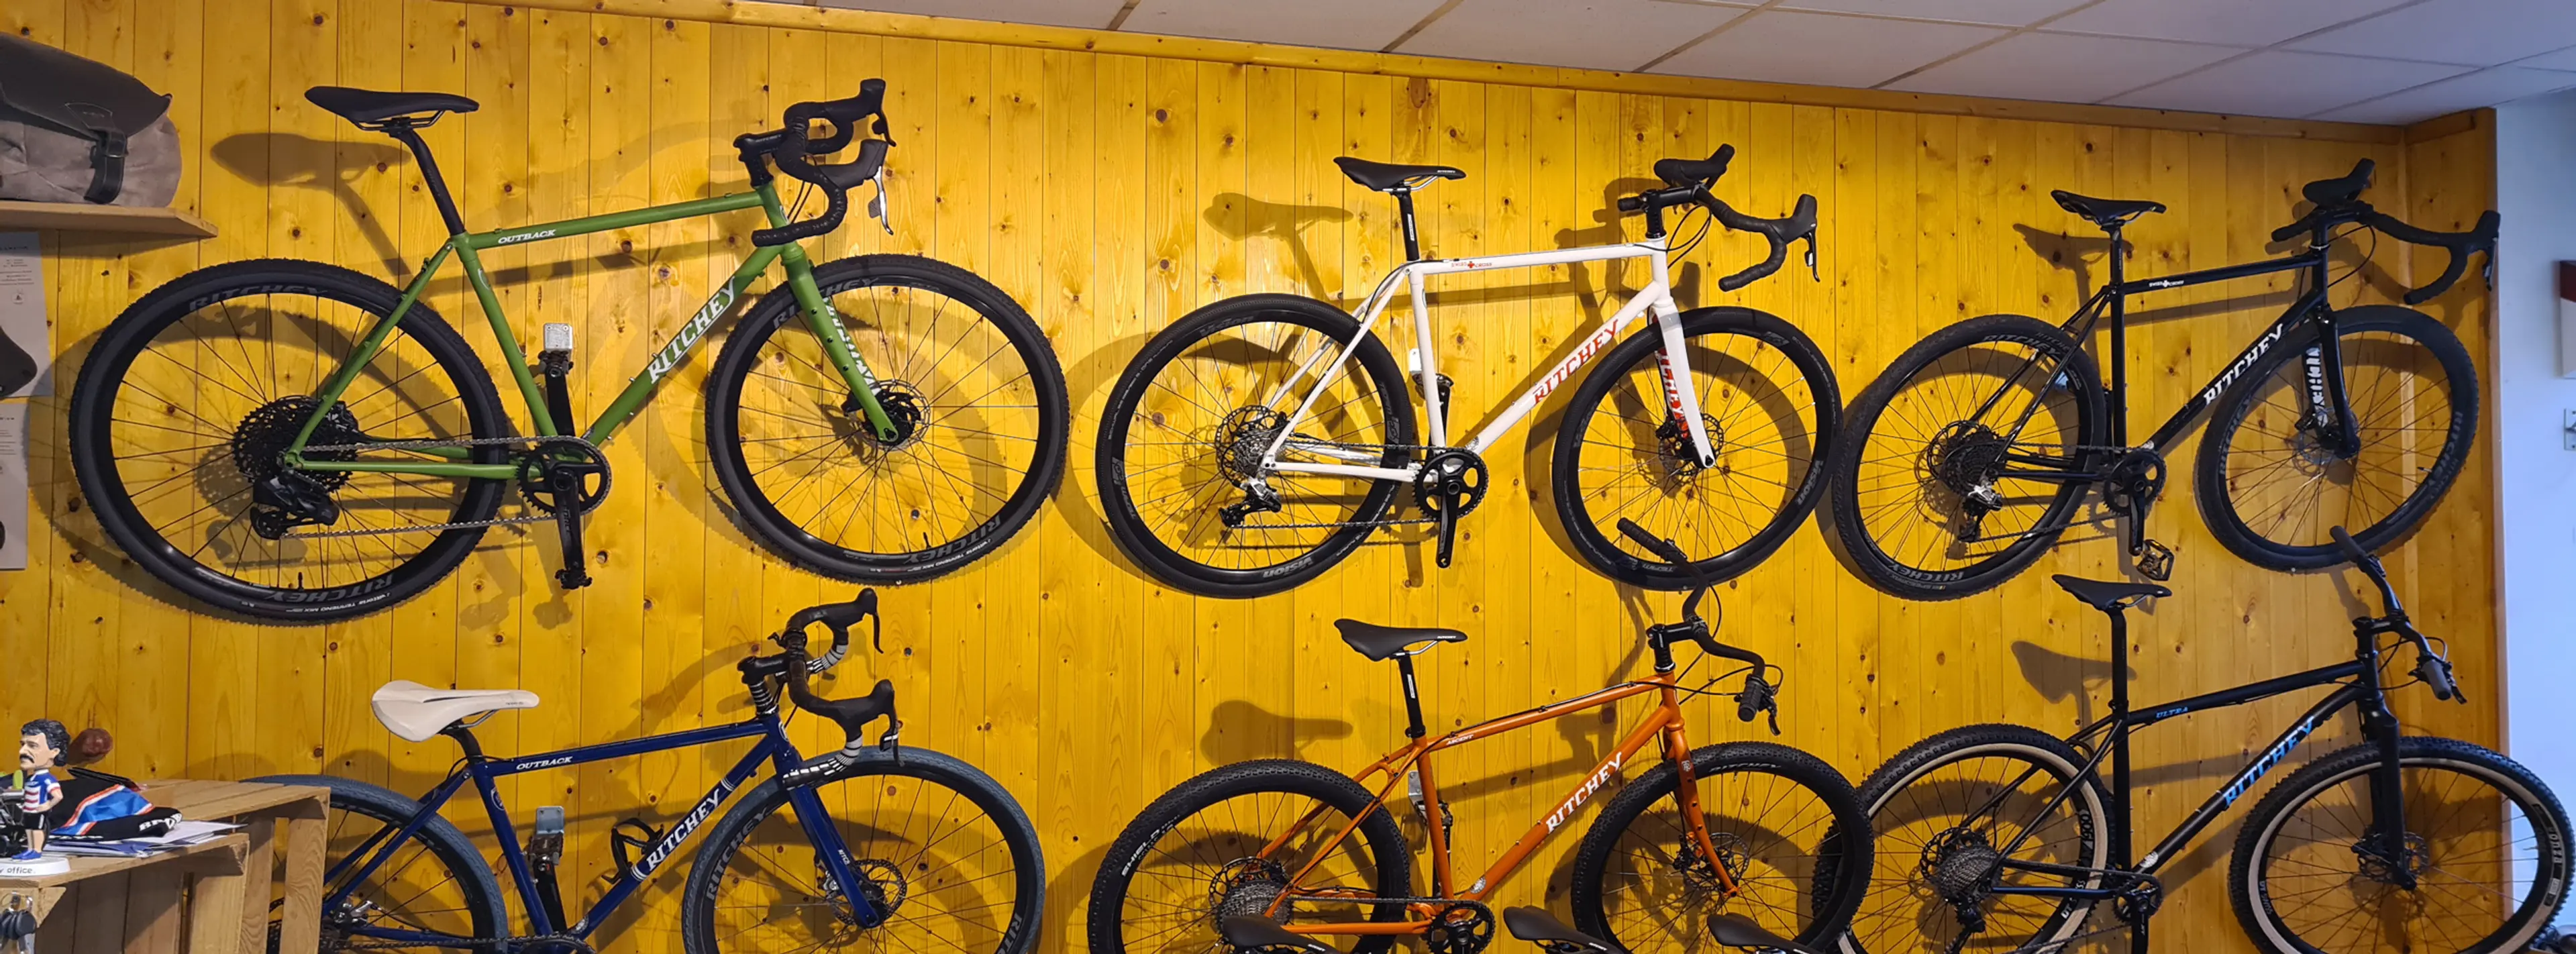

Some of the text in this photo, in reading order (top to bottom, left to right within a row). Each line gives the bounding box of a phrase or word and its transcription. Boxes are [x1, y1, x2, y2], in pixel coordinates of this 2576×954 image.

[498, 229, 556, 244] OUTBACK
[773, 277, 879, 328] RIHEY
[648, 276, 735, 384] RITCHEY
[1981, 334, 2061, 355] RITCHEY
[1533, 319, 1618, 403] RITCHEY
[2204, 323, 2284, 406] RITCHEY
[904, 515, 1002, 565] RITCHEY
[267, 574, 393, 602] RITCHEY
[1889, 564, 1964, 582] RITCHEY
[2156, 706, 2188, 719] ULTRA
[516, 756, 574, 771] OUTBACK
[1447, 734, 1474, 745] ASCENT
[2222, 716, 2314, 806] RITCHEY
[1546, 751, 1622, 834] RITCHEY
[646, 788, 720, 871] RITCHEY
[706, 806, 769, 901] RITCHEY
[1121, 829, 1160, 877] SHIELD
